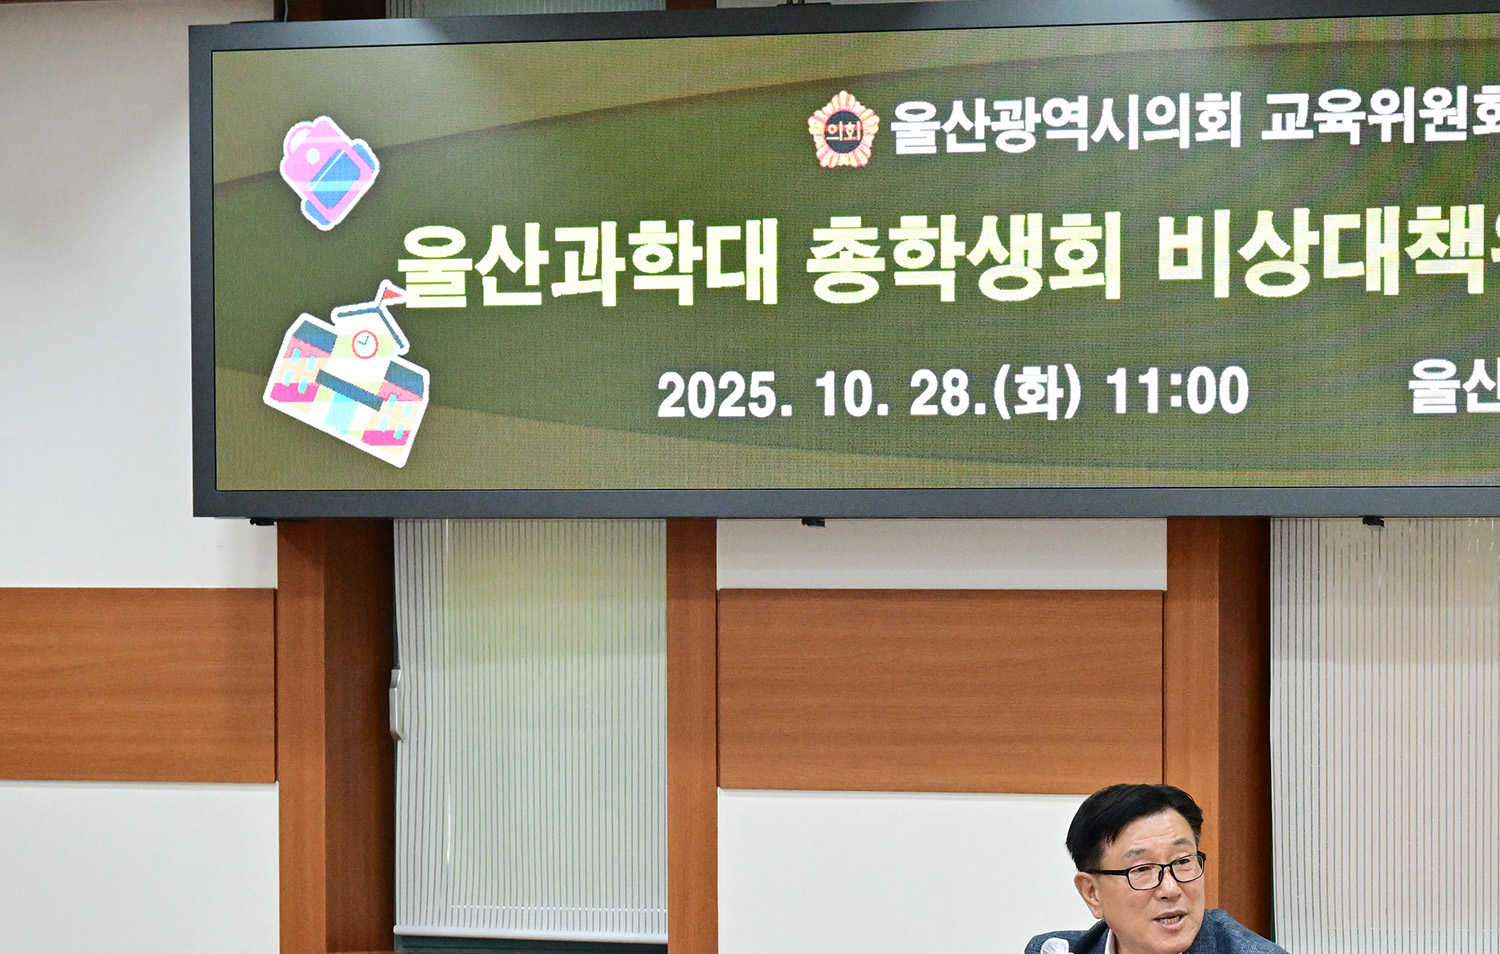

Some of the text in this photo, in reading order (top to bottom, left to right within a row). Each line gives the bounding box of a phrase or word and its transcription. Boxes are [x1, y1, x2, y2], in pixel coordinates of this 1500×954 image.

[824, 120, 862, 142] 의회
[890, 91, 1242, 155] 울산광역시의회
[397, 217, 778, 309] 울산과학대
[806, 210, 1121, 304] 총학생회
[657, 363, 1249, 421] 2025. 10. 28.(화) 11:00
